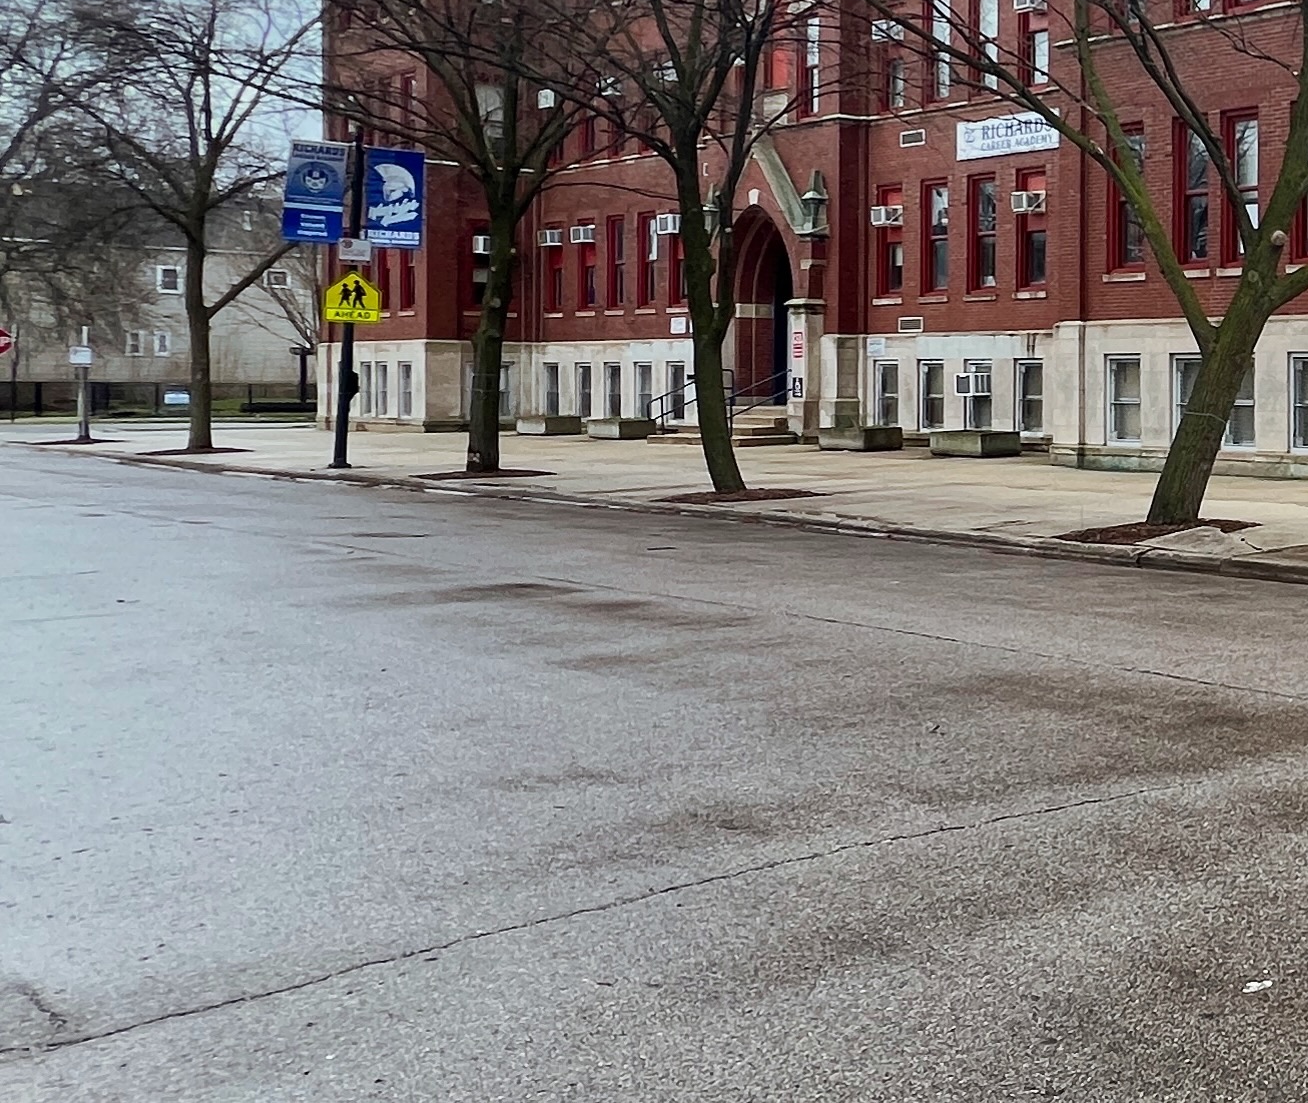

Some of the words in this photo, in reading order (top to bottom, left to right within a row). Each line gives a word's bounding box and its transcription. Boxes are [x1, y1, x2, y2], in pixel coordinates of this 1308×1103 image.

[980, 140, 1011, 151] CAREER
[1015, 134, 1054, 146] ACADEMY
[335, 310, 371, 320] AHEAD
